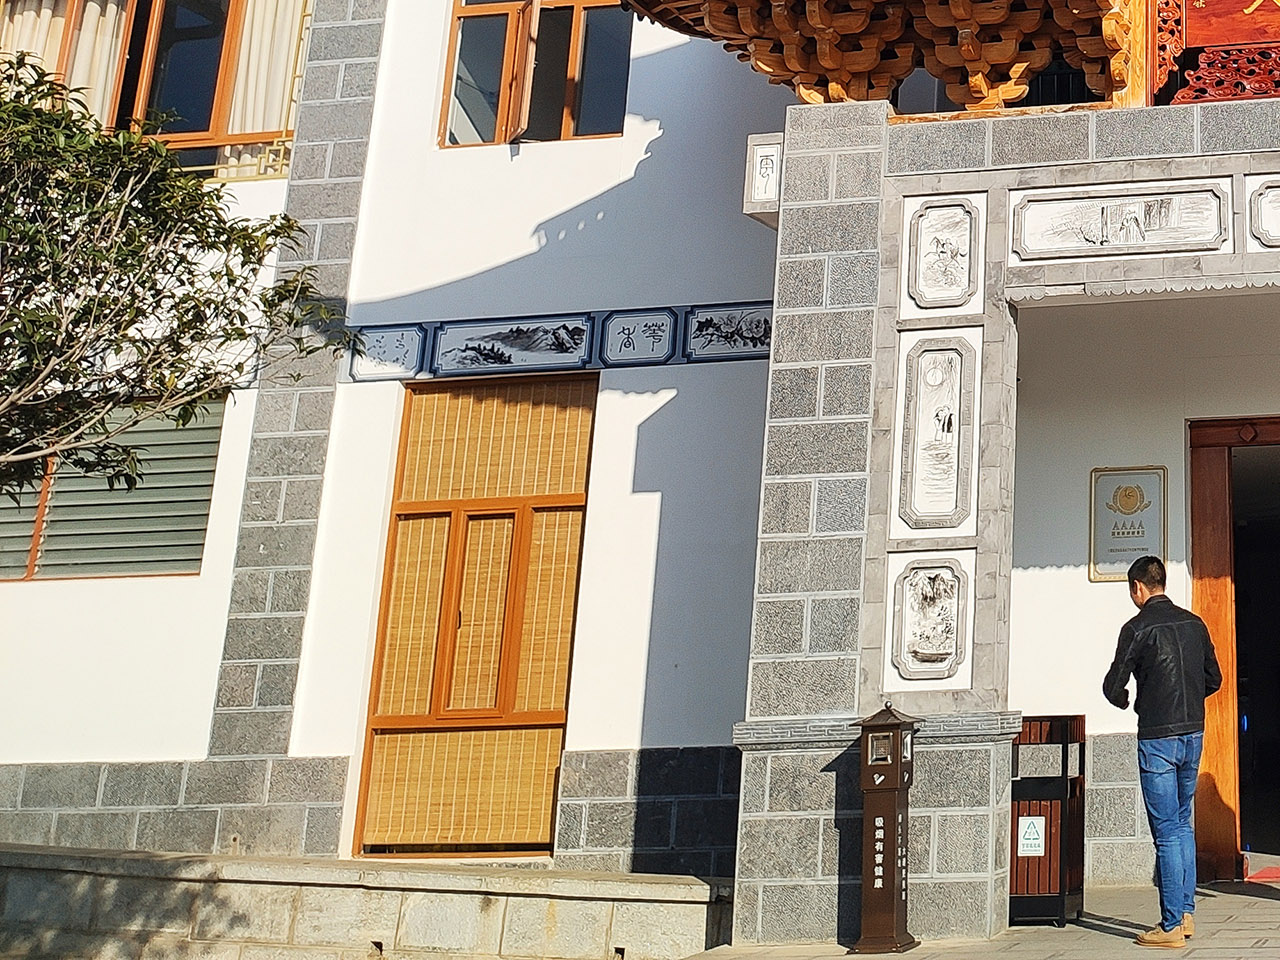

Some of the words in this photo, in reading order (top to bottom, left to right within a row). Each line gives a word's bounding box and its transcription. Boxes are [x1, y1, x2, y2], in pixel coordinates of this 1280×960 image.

[873, 816, 884, 889] 吸烟有害健康
